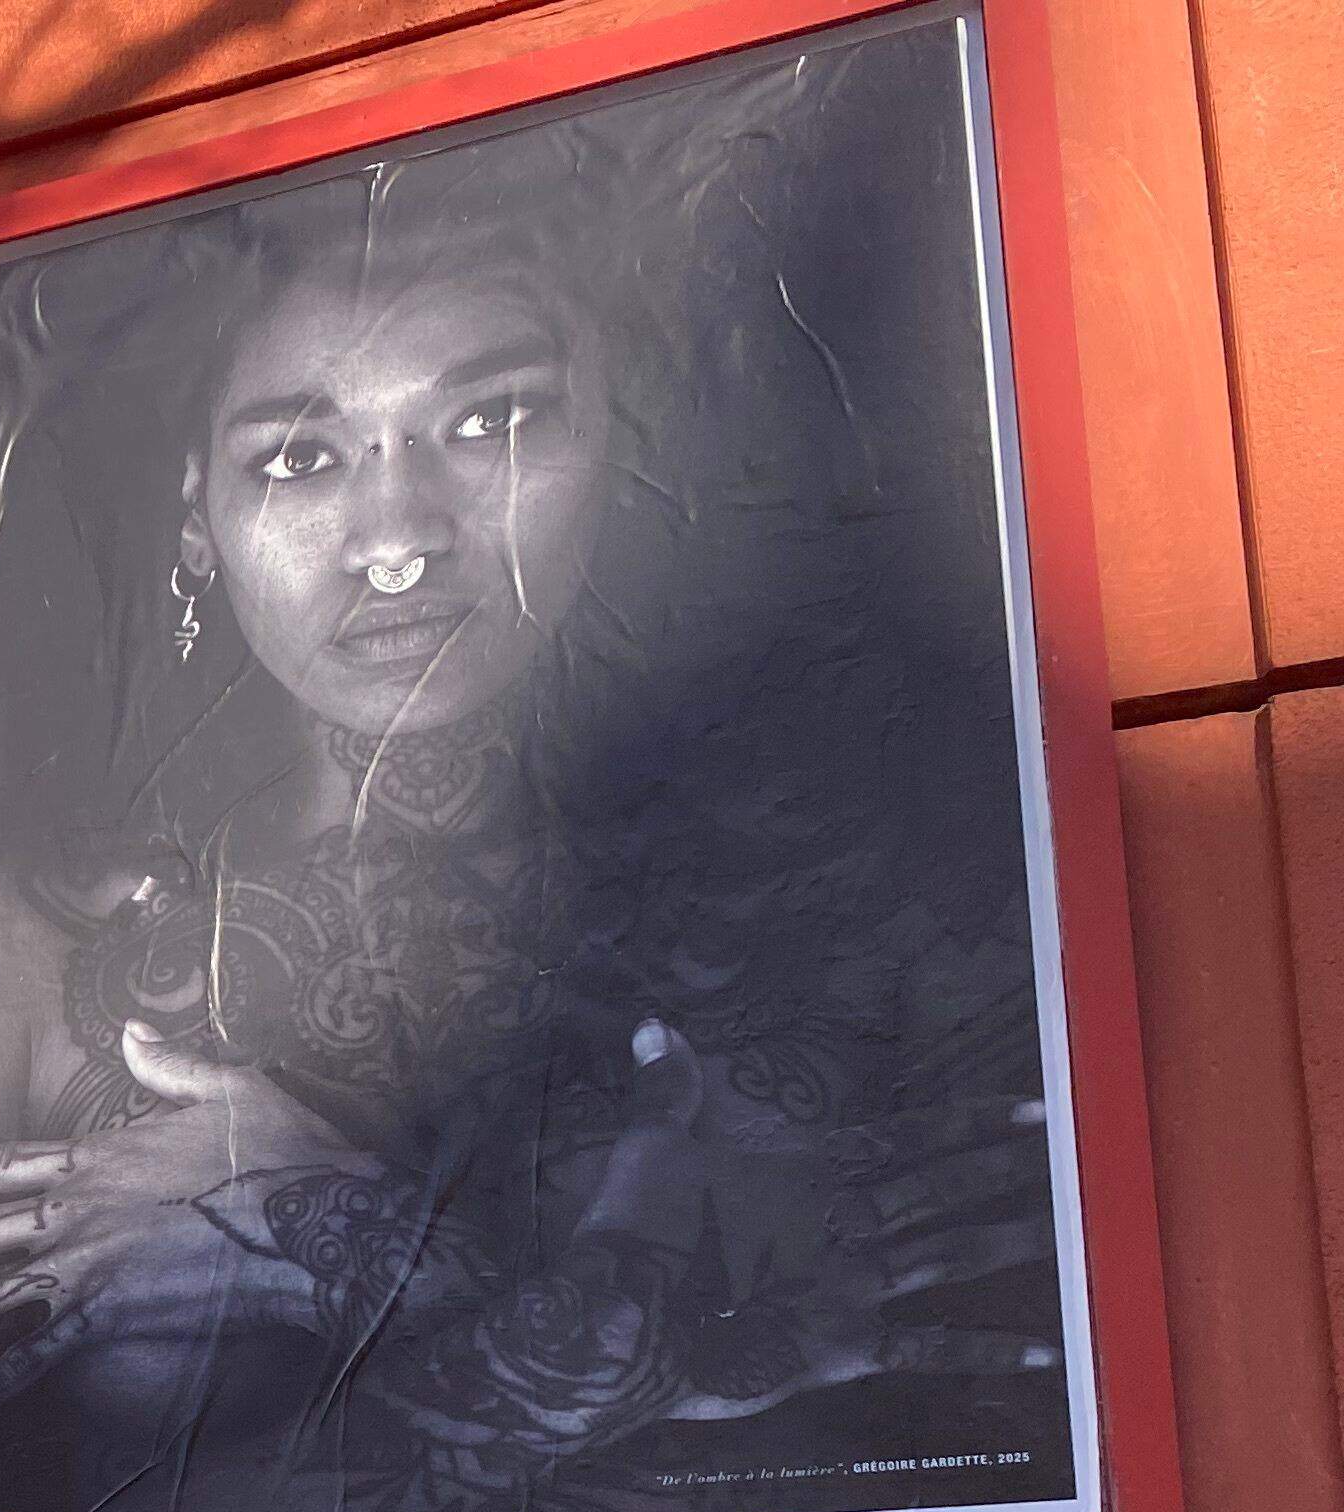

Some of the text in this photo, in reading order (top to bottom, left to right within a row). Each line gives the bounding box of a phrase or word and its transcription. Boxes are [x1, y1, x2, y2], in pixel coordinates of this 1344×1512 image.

[745, 1468, 755, 1481] à
[760, 1468, 774, 1480] la
[853, 1458, 916, 1474] GRÉGOIRE
[921, 1453, 993, 1469] GARDETTE,
[997, 1451, 1030, 1464] 2025
